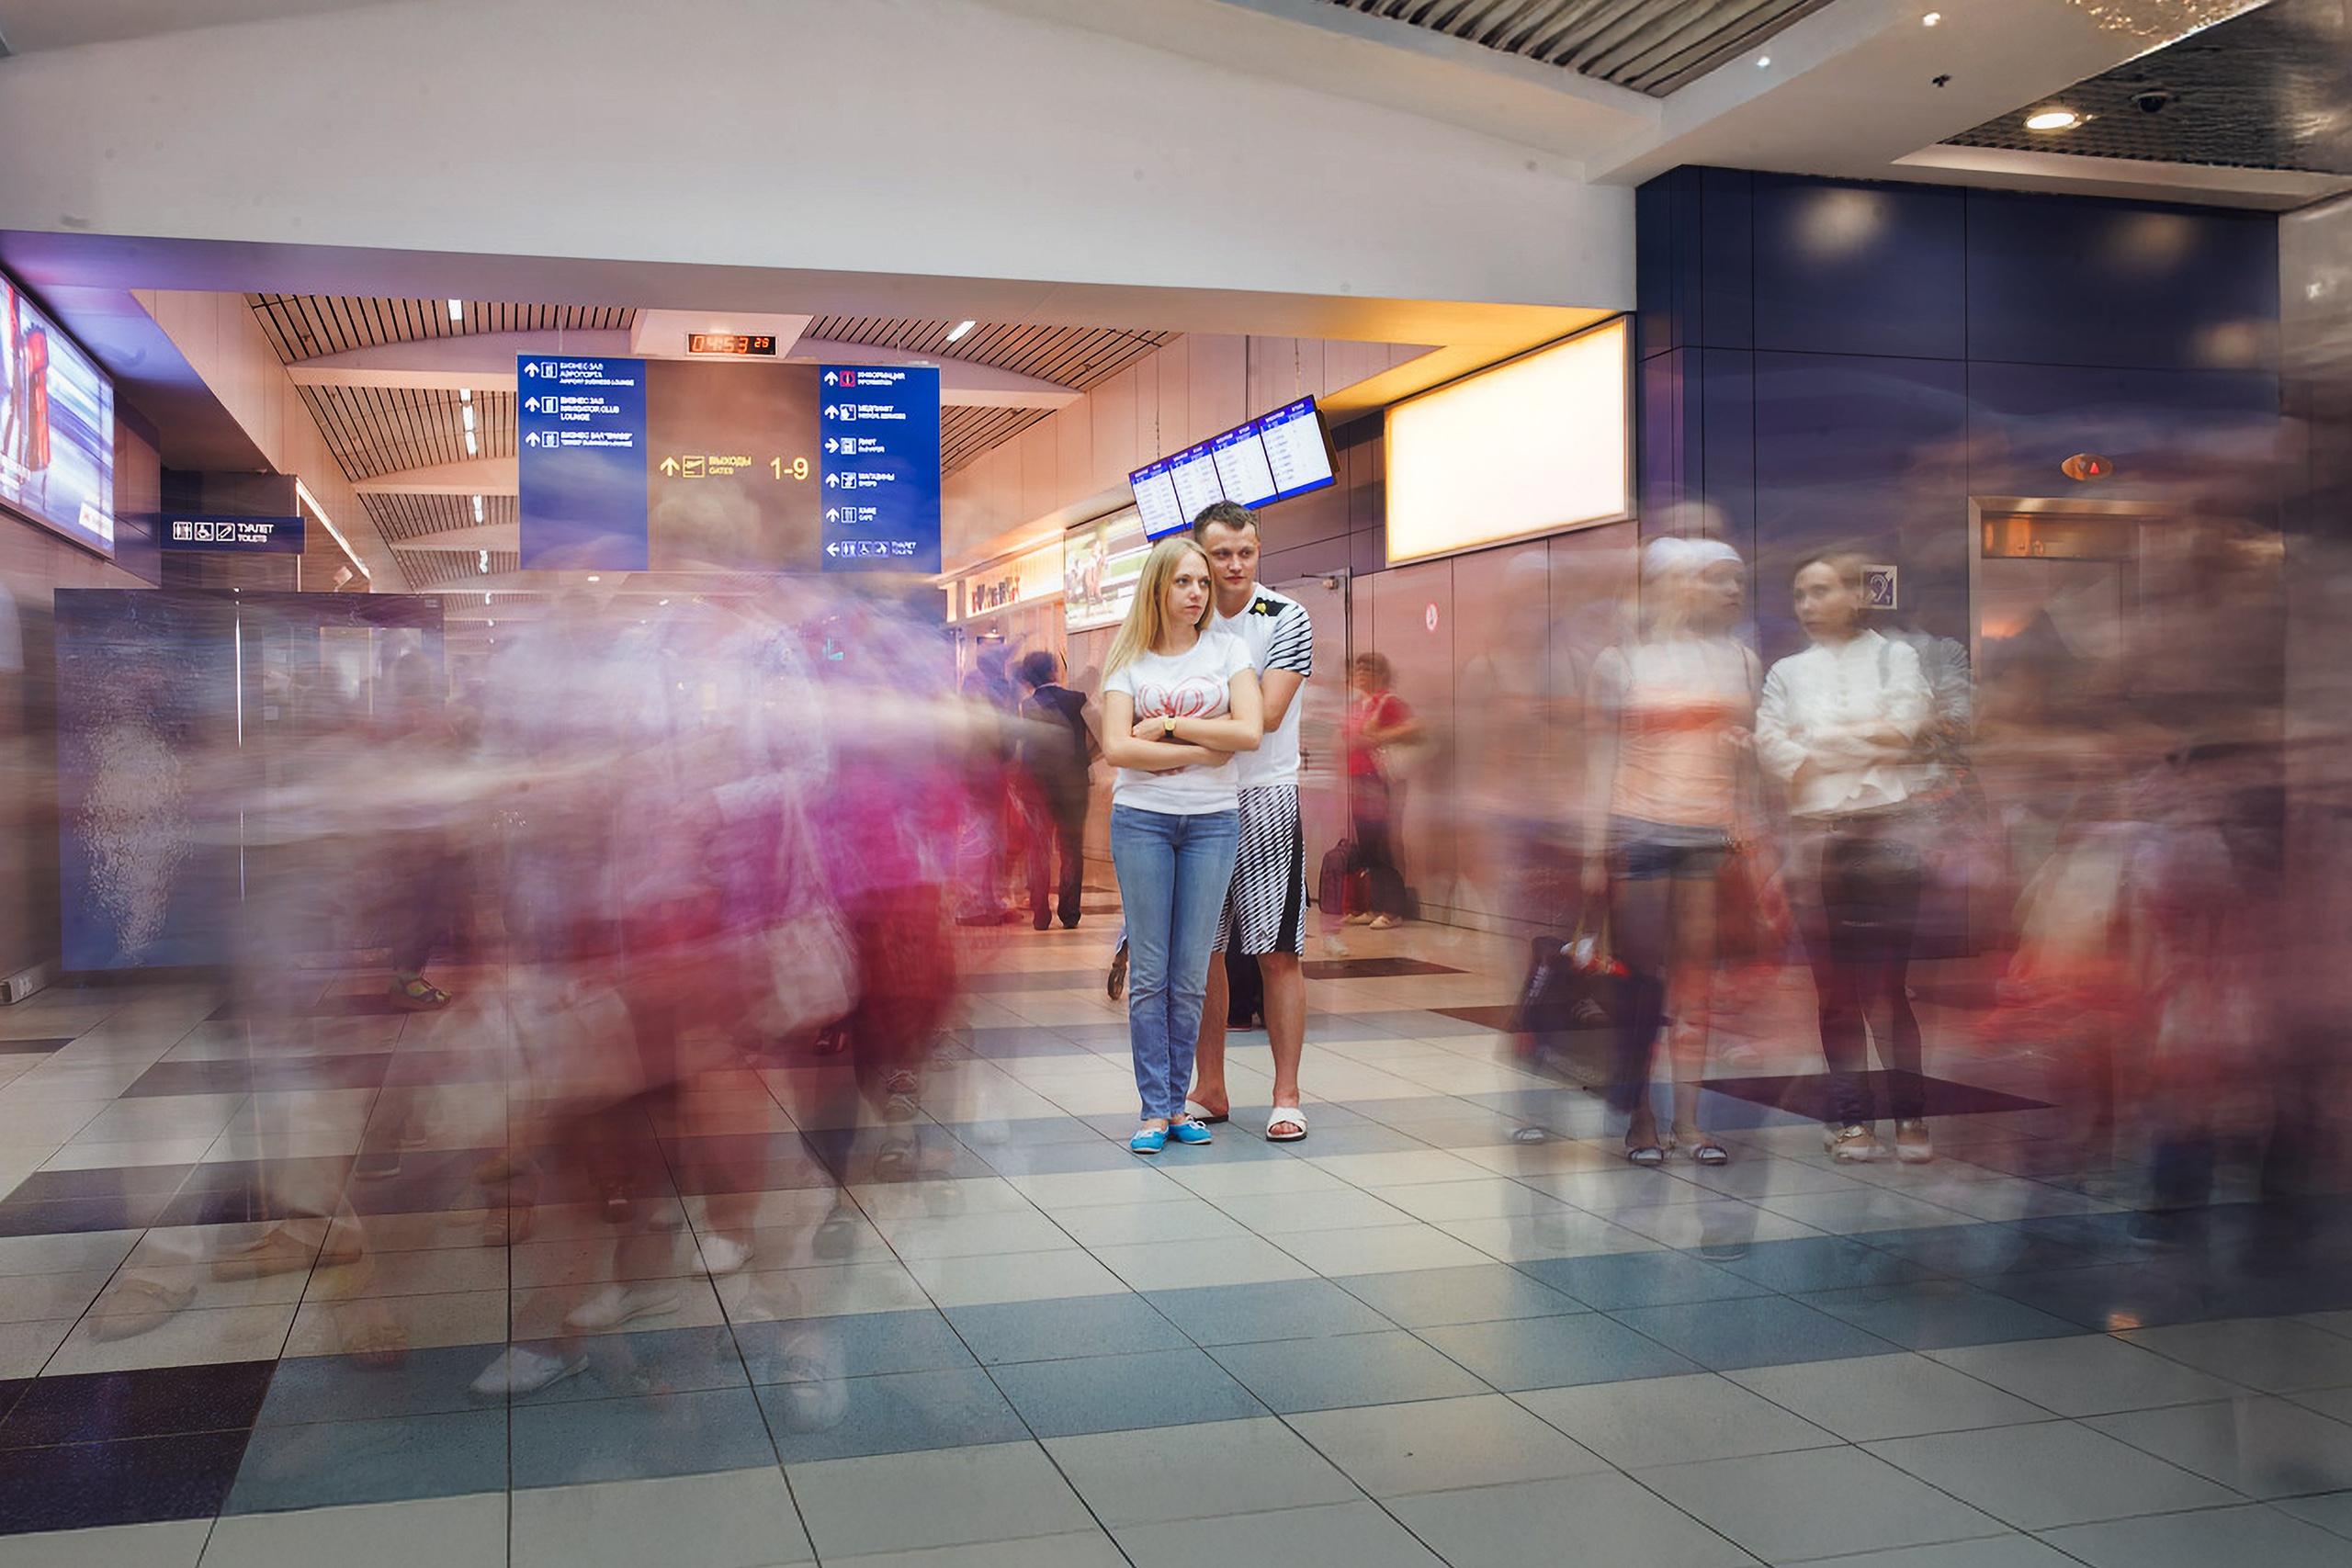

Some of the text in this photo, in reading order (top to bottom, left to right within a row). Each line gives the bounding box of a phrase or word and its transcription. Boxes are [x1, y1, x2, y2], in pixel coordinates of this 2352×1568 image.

[708, 455, 752, 467] ВЫХОДЫ
[708, 467, 734, 475] GATES
[770, 457, 808, 480] 1-9
[237, 523, 274, 533] ТУАЛЕТ
